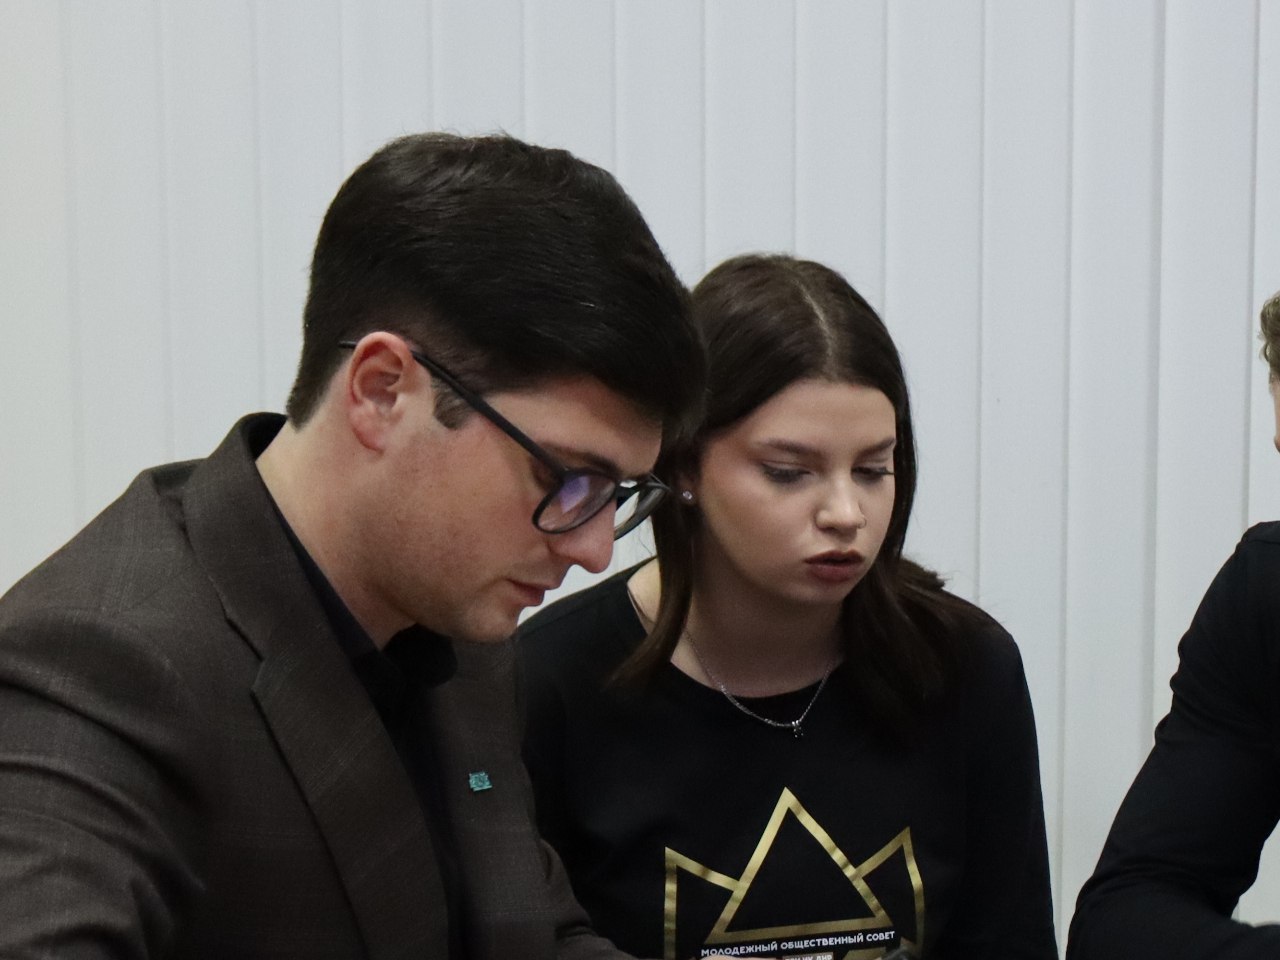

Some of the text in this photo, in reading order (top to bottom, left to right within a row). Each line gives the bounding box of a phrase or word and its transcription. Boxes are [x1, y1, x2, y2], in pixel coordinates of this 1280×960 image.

[701, 930, 896, 957] МОЛОДЕЖНЫЙ ОБЩЕСТВЕННЫЙ СОВЕТ
